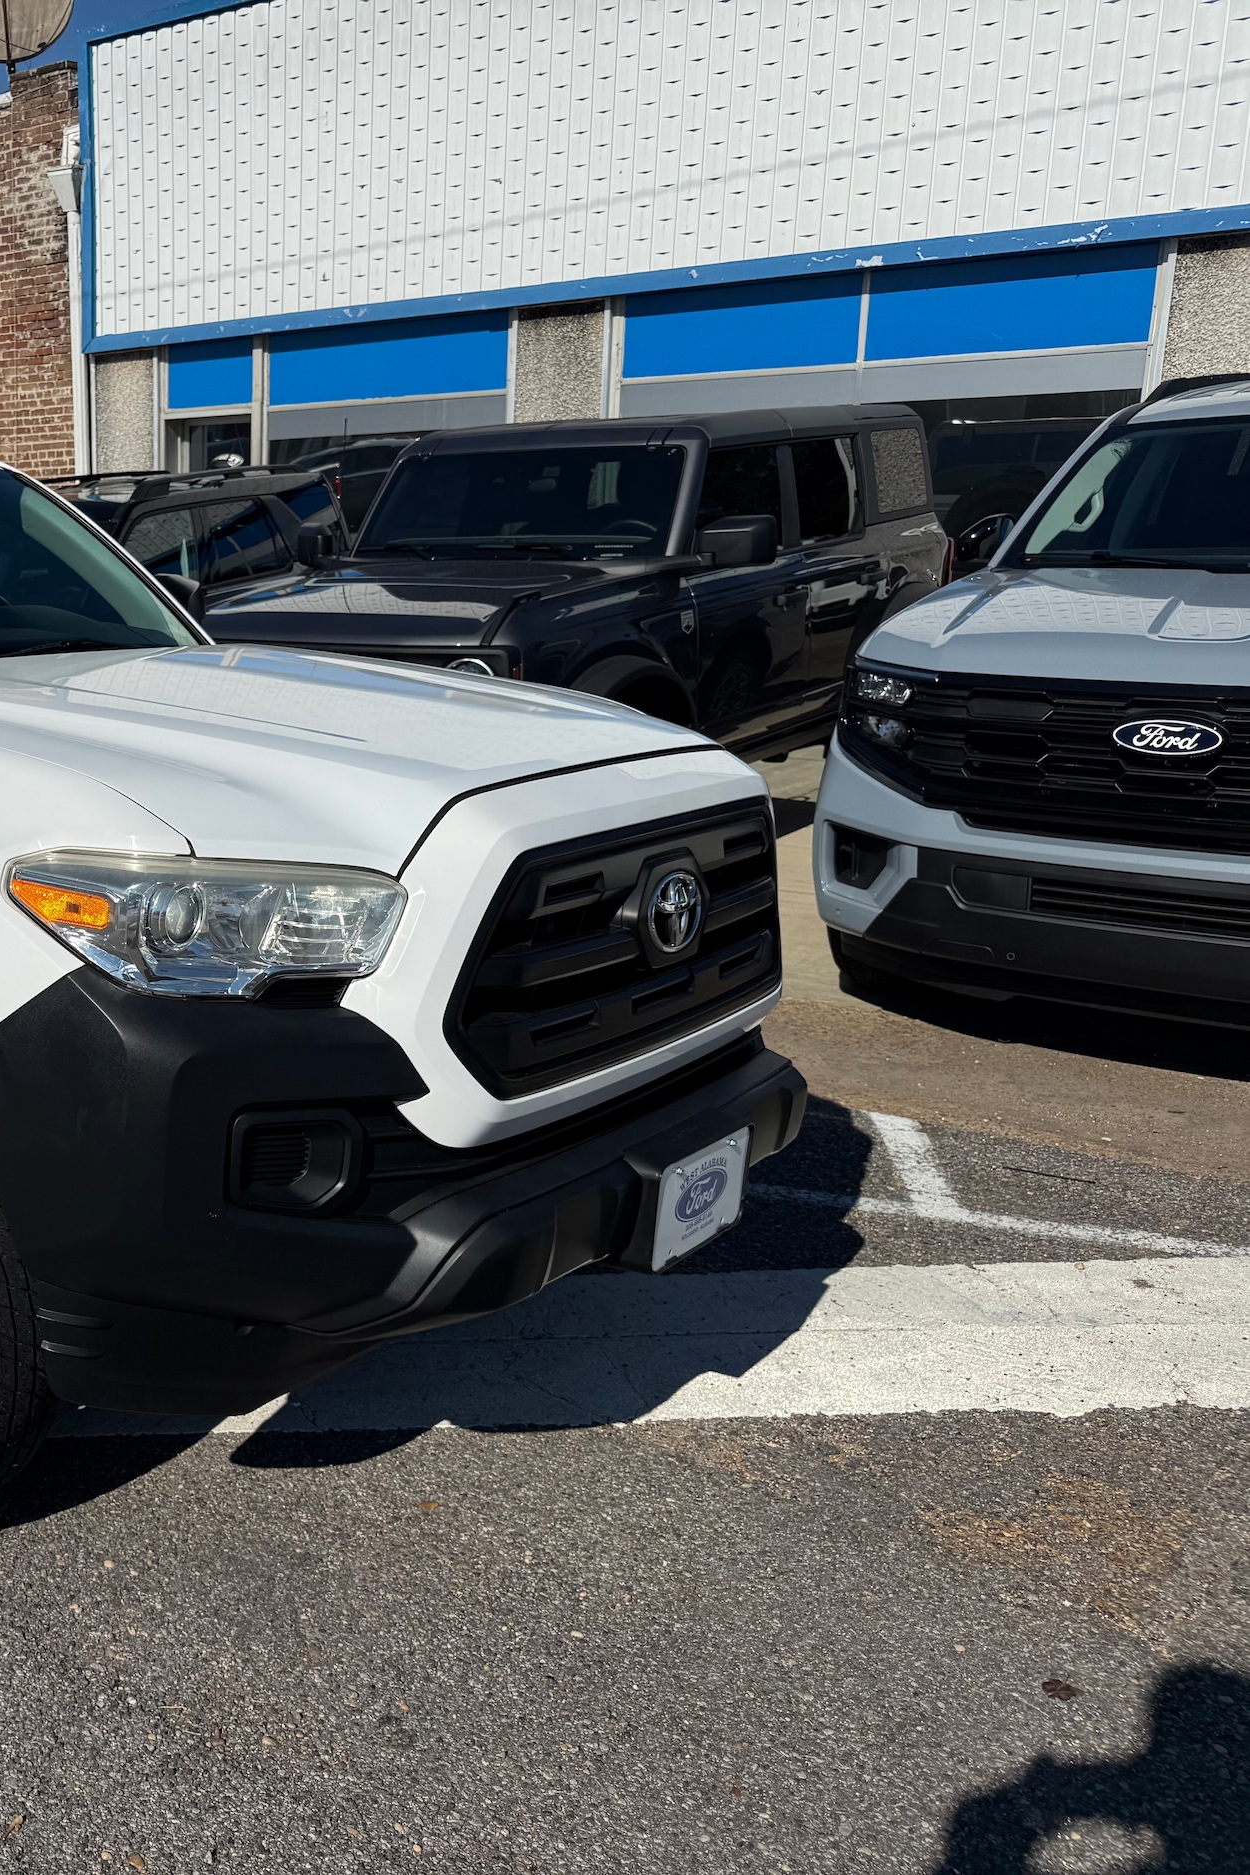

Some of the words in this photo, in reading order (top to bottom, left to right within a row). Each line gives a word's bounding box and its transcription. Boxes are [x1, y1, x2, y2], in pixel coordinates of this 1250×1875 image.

[1132, 723, 1201, 750] Ford
[679, 1167, 699, 1191] WEST
[700, 1157, 727, 1173] ALABAMA
[686, 1176, 718, 1215] Ford
